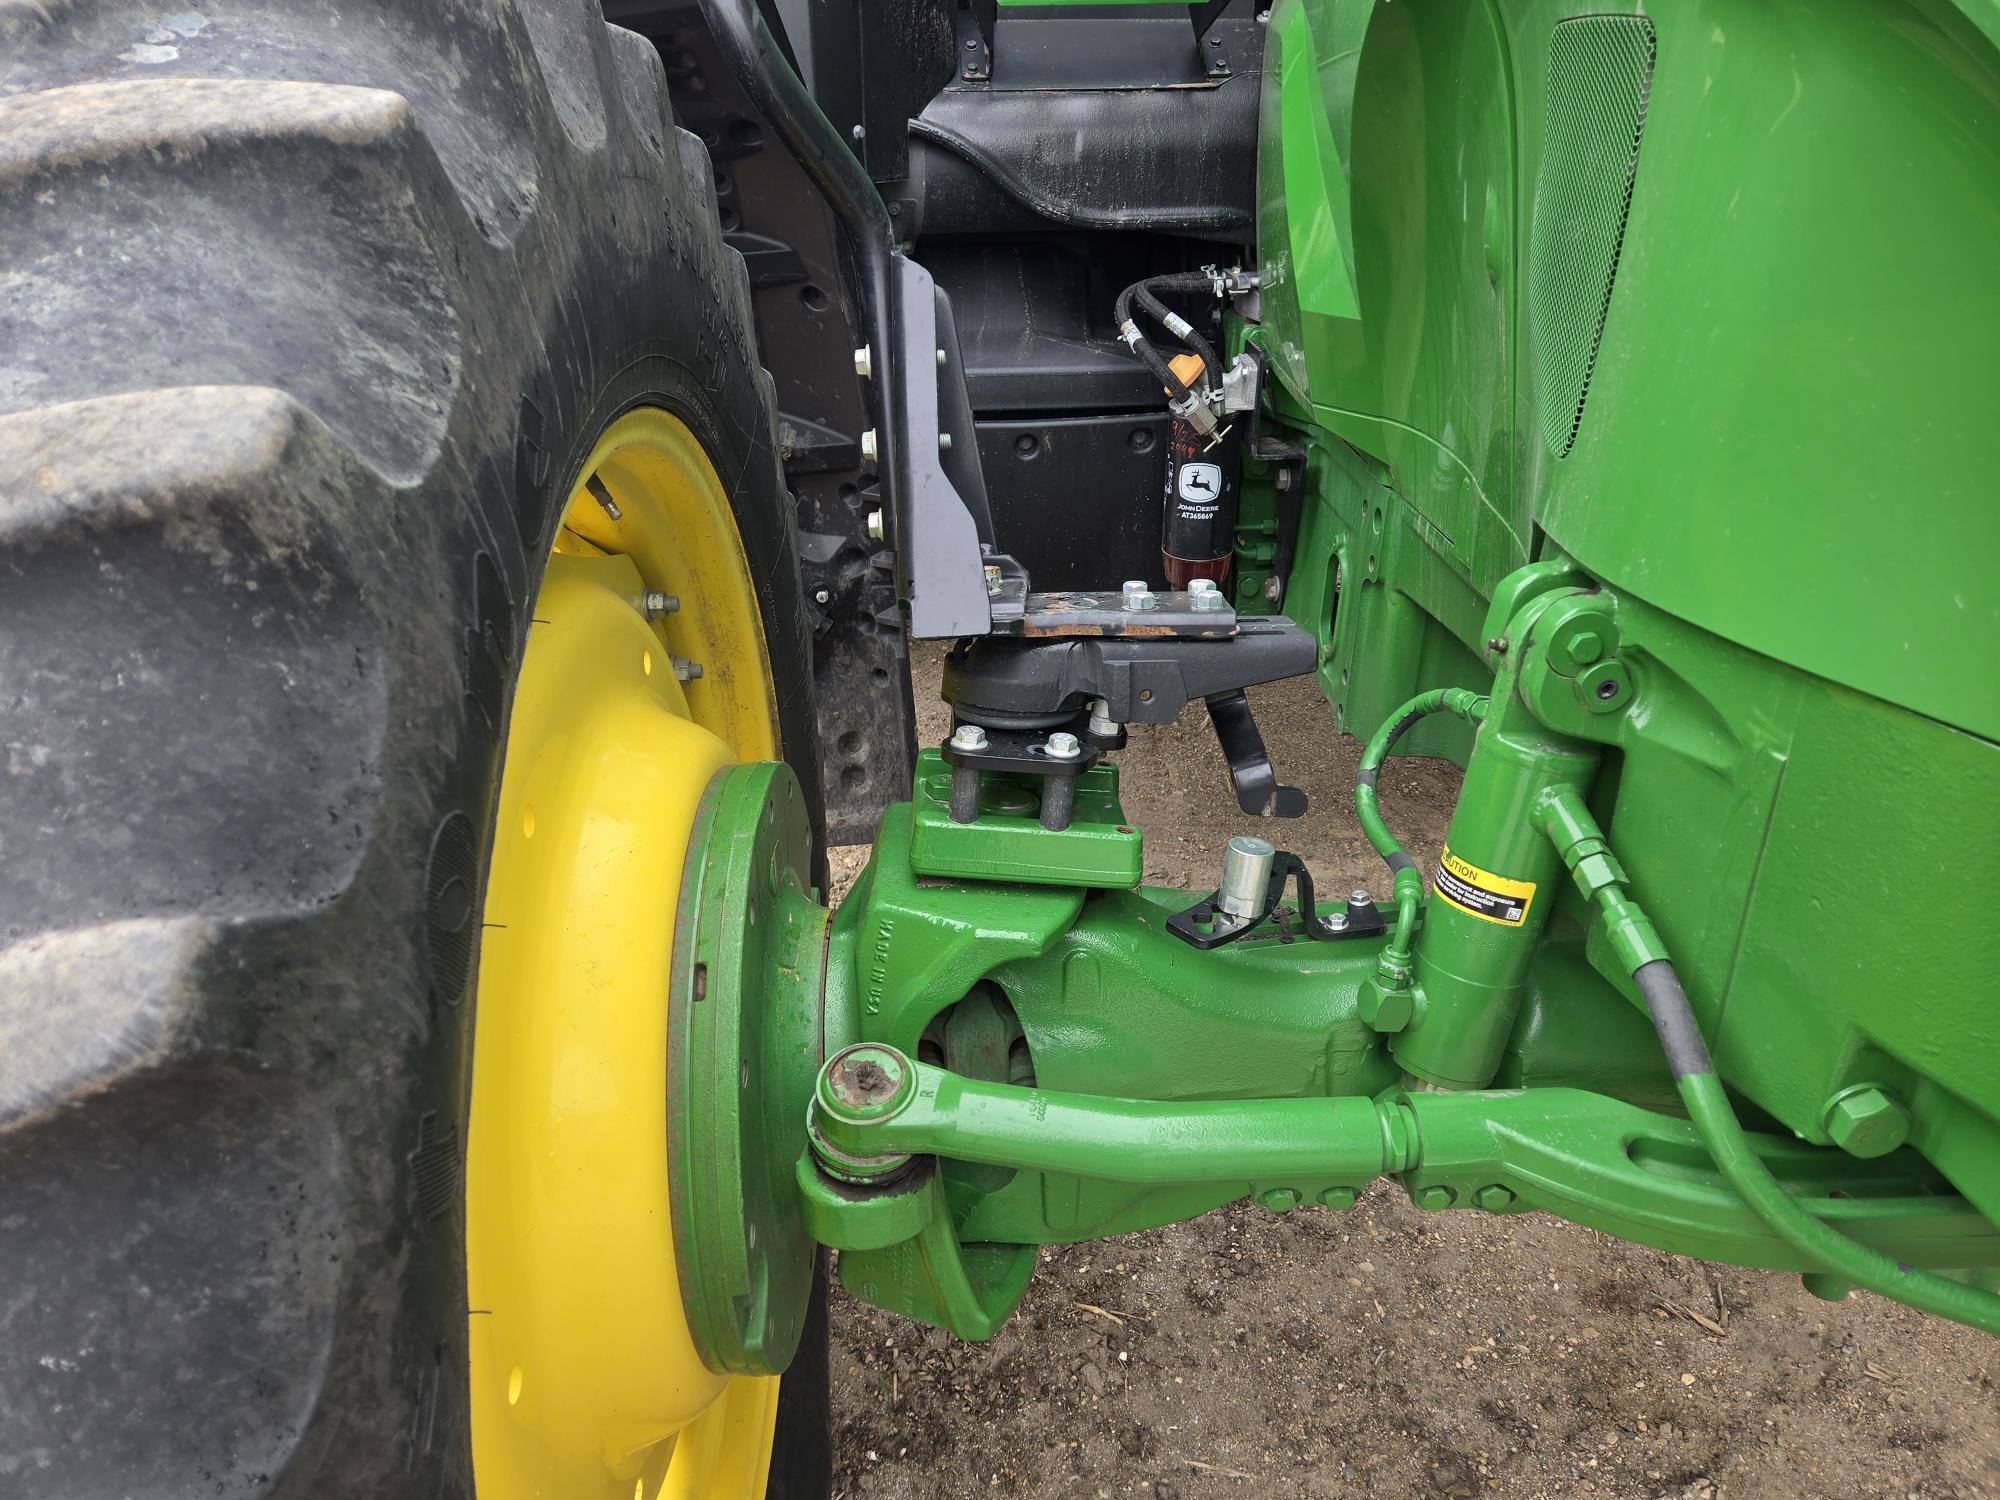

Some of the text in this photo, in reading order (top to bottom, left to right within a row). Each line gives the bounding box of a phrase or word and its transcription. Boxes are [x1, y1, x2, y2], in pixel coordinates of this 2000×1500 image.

[1177, 503, 1196, 511] JOHN
[1473, 889, 1486, 898] and
[1485, 894, 1516, 906] exposure
[865, 987, 883, 1016] USA
